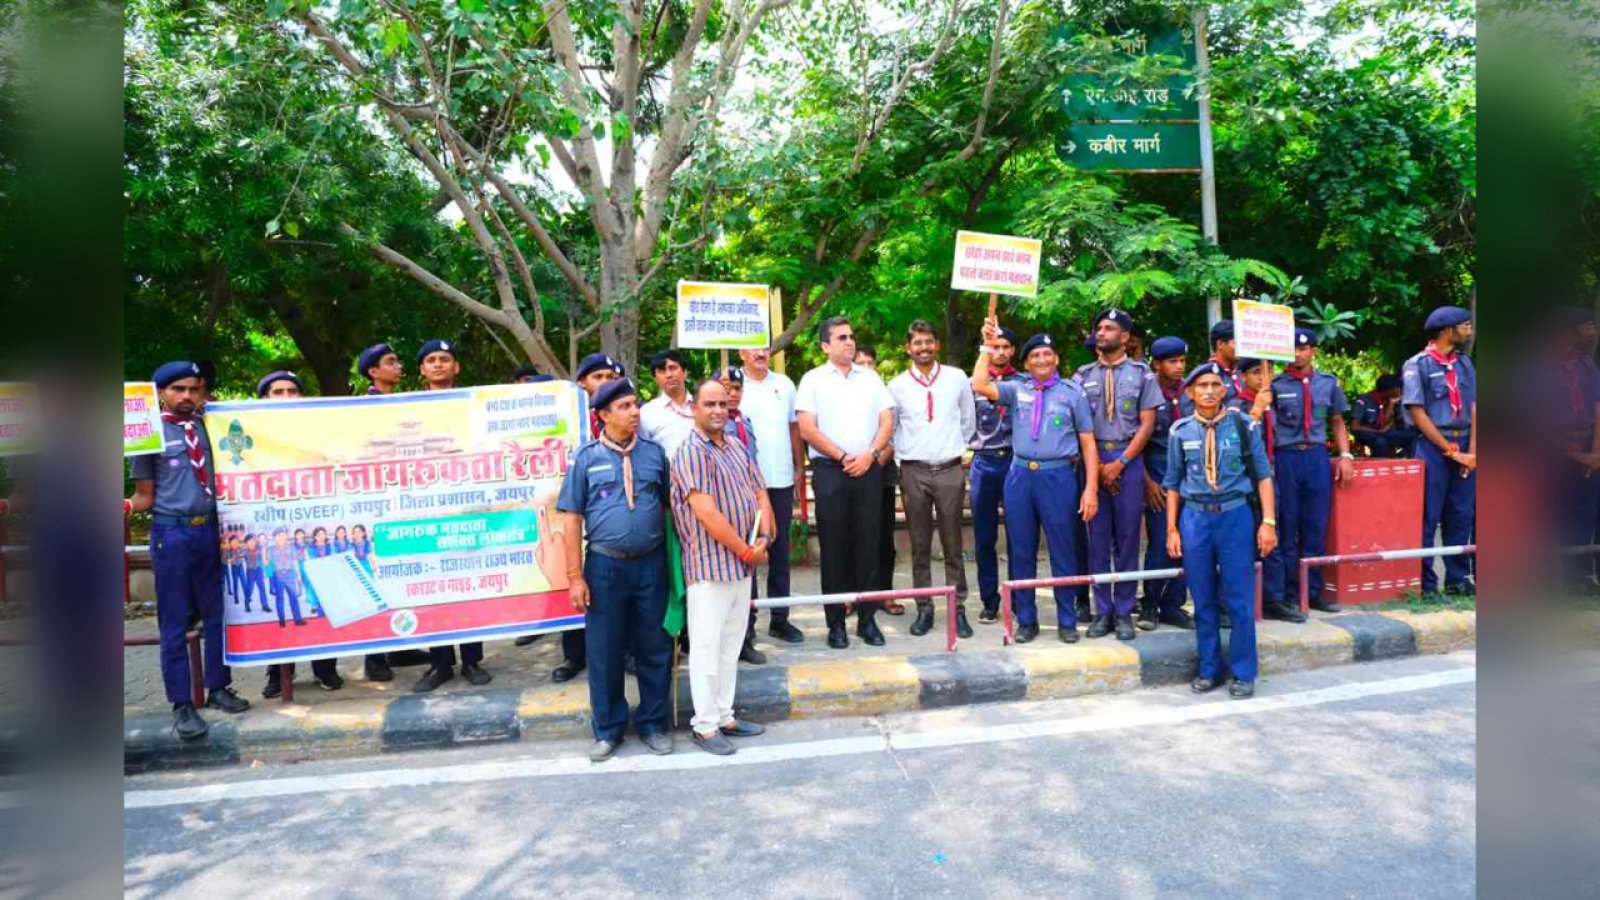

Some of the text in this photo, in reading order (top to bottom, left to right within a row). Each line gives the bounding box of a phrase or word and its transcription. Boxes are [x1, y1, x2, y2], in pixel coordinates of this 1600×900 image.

[1086, 132, 1160, 154] कबीर मार्ग
[214, 465, 336, 505] मतदाता
[501, 436, 569, 482] रैली
[253, 504, 286, 523] स्वीप
[289, 504, 345, 522] (SVEEP)
[350, 499, 391, 517] जयपुर
[400, 491, 435, 510] जिला
[495, 485, 536, 503] जयपुर
[509, 549, 534, 566] भारत
[478, 573, 508, 594] जयपुर
